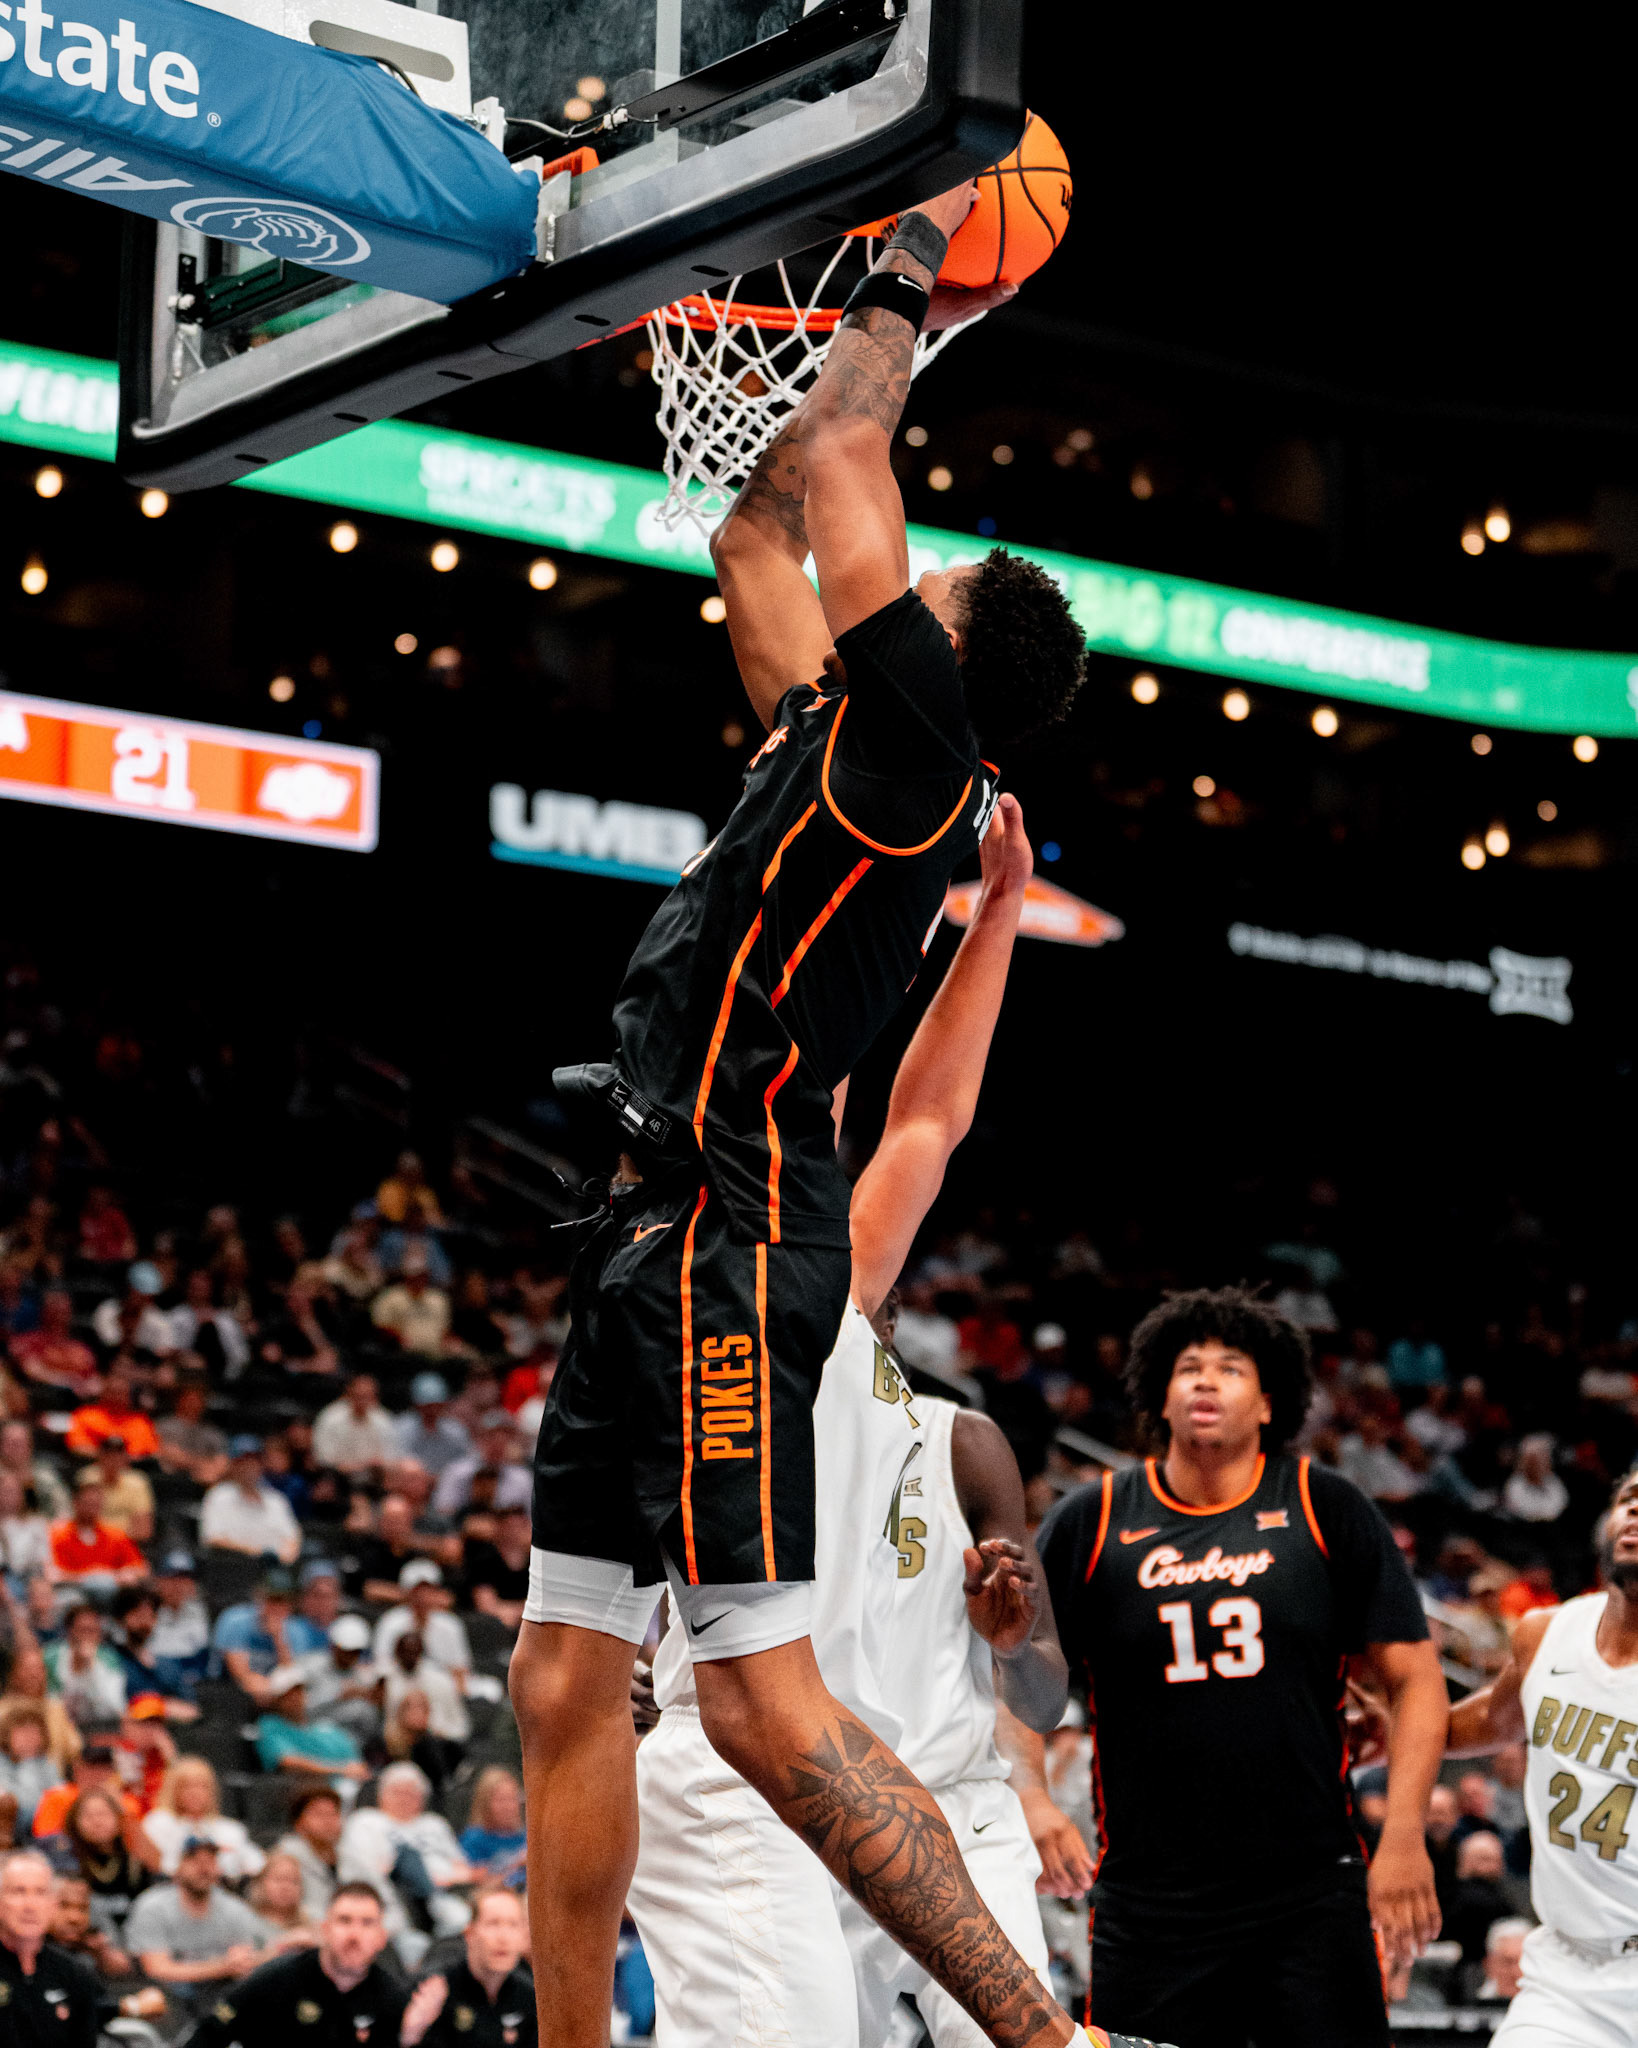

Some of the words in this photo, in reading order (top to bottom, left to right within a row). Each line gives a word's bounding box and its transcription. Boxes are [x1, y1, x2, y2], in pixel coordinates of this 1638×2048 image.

[111, 726, 196, 811] 21
[489, 781, 708, 872] UMB
[701, 1334, 754, 1460] POKES
[1138, 1544, 1275, 1590] Cowboys
[1158, 1596, 1265, 1684] 13
[1549, 1771, 1636, 1862] 24
